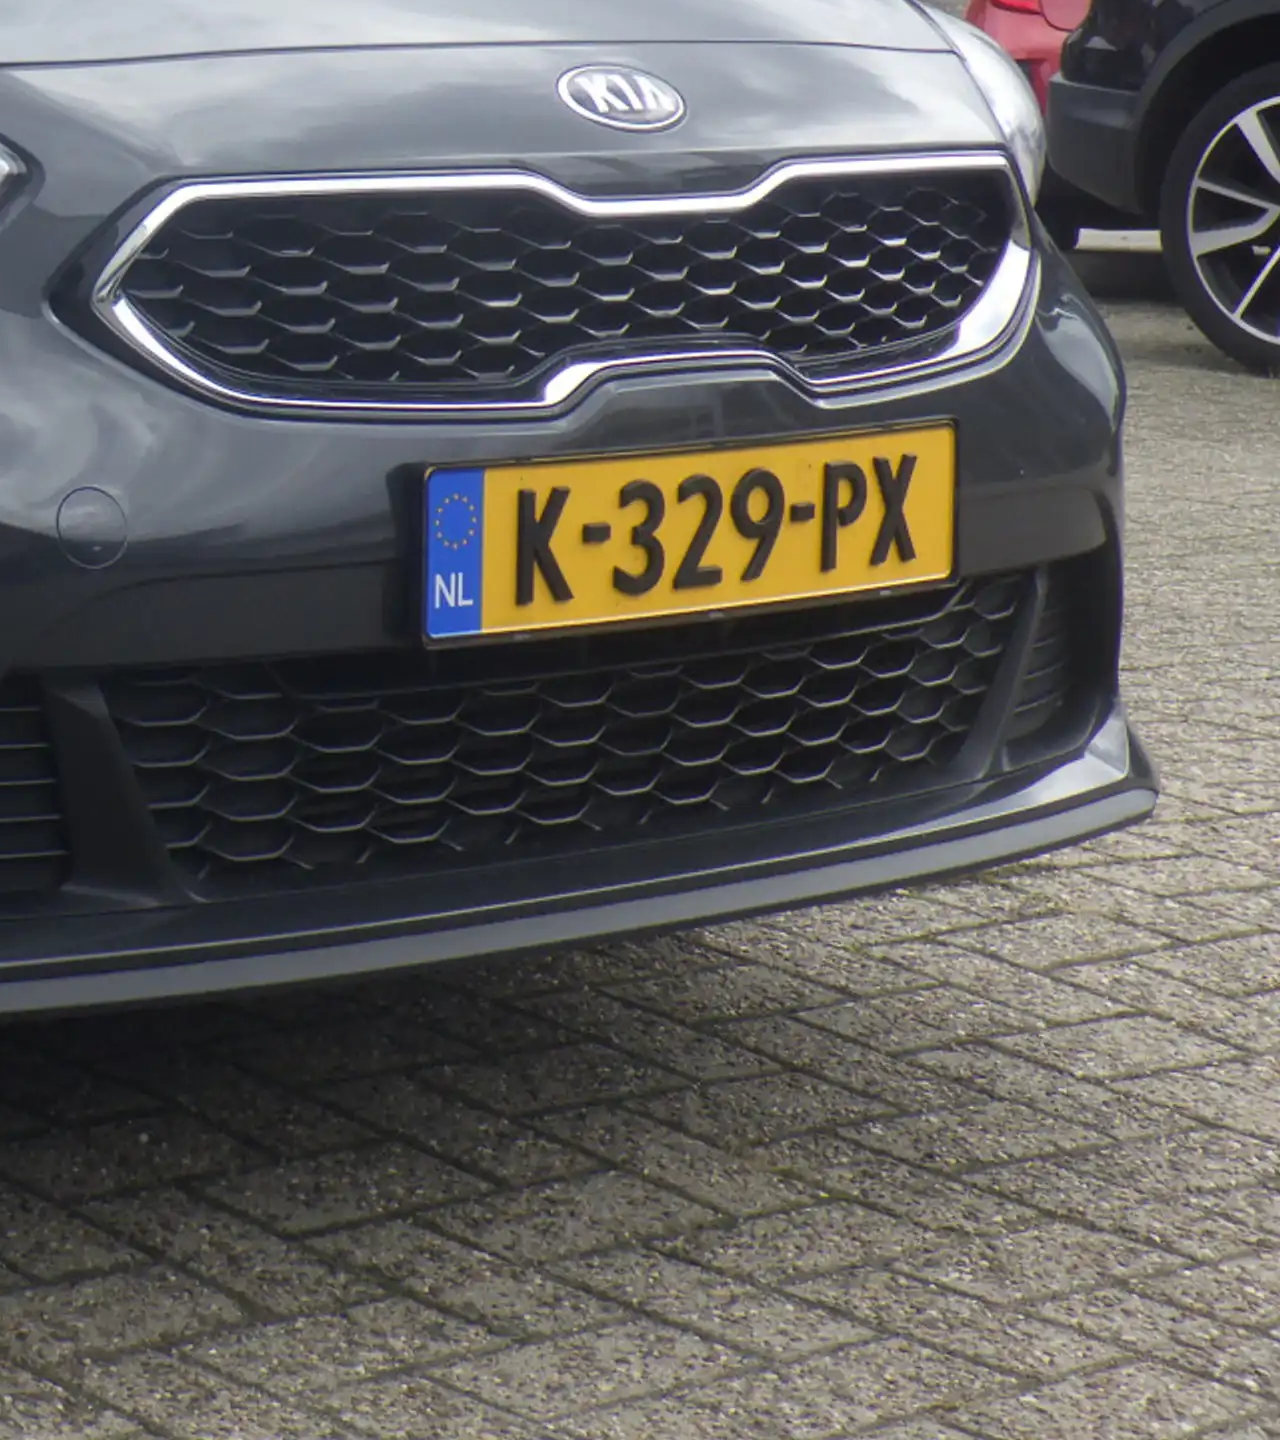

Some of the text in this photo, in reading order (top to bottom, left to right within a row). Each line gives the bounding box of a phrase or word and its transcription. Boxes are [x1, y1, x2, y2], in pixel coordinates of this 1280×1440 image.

[573, 73, 677, 114] KIA
[515, 453, 917, 607] K-329-PX
[434, 572, 474, 609] NL
